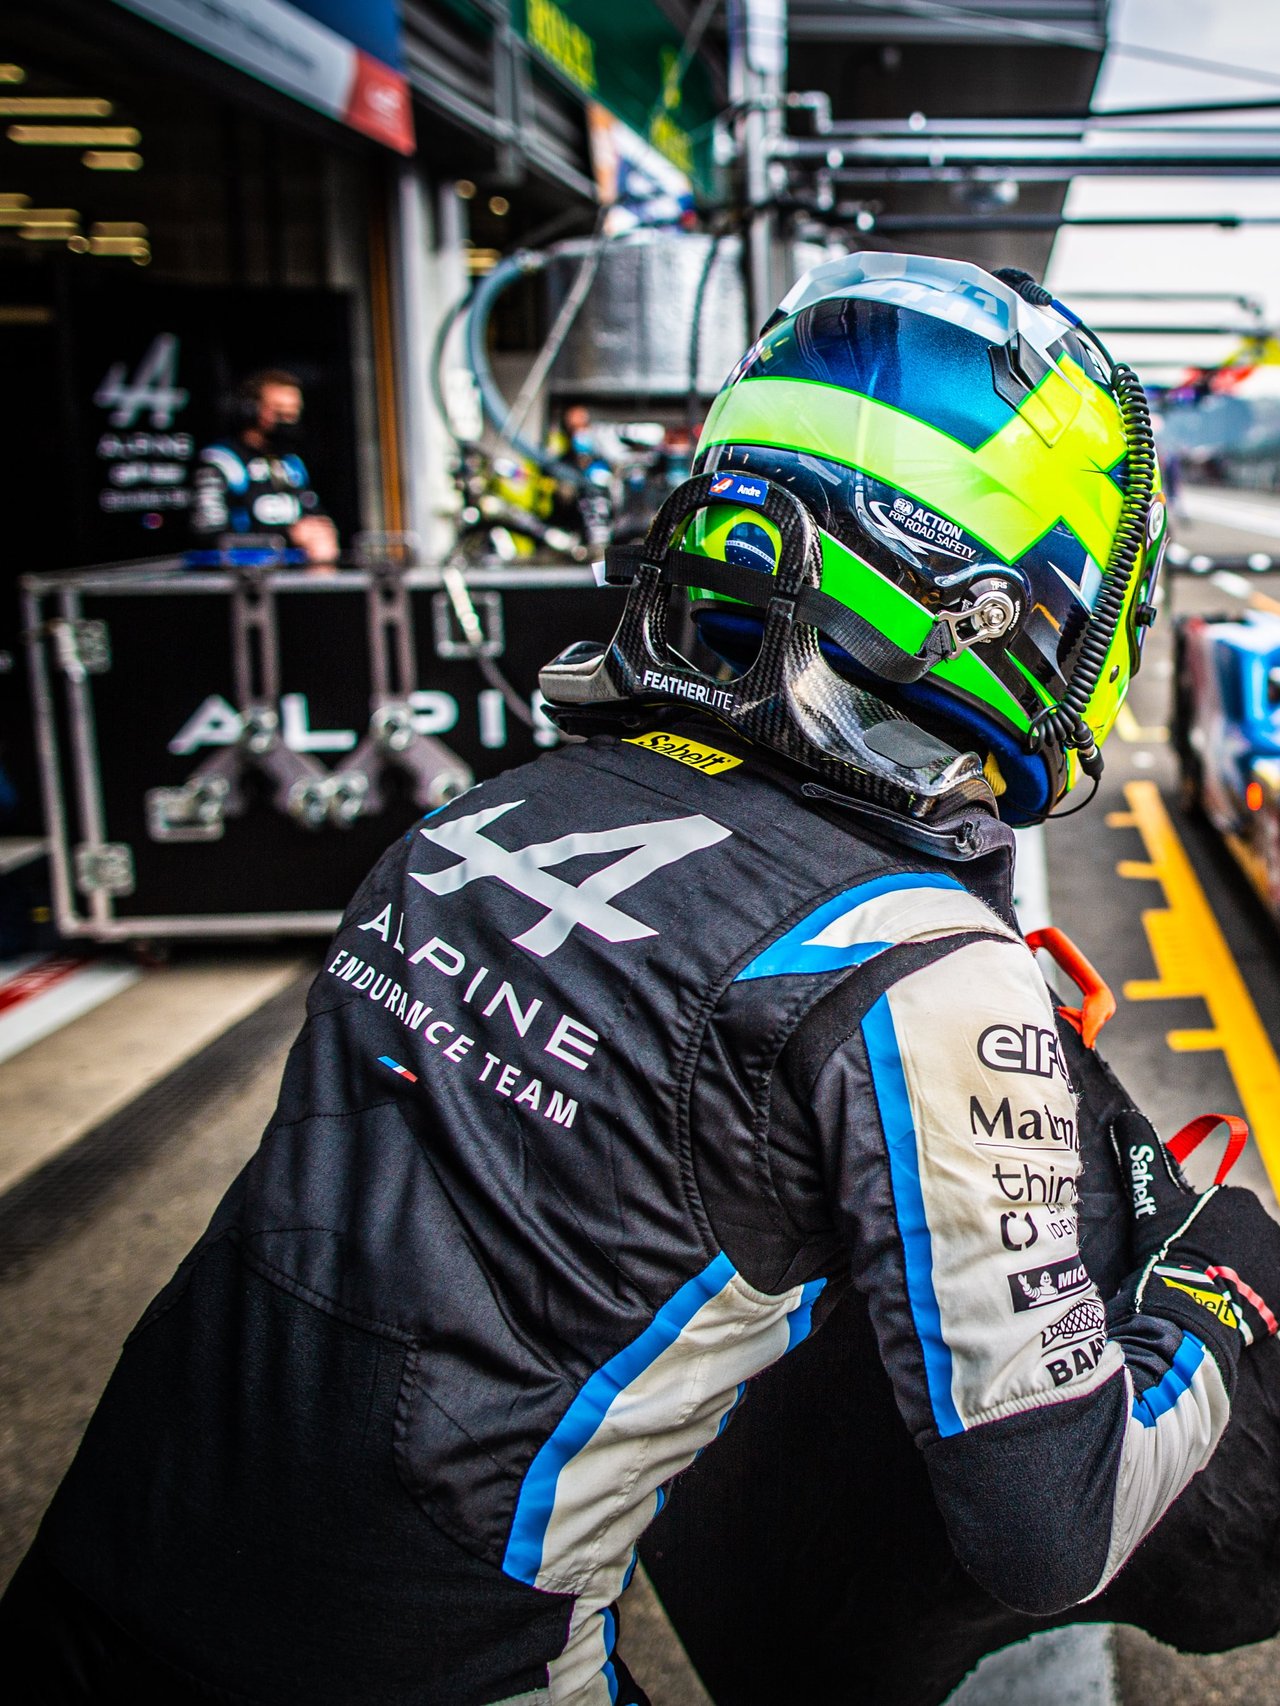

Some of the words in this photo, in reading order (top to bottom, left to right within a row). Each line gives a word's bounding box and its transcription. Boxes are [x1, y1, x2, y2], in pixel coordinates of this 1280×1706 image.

[736, 484, 762, 498] Andre
[888, 510, 906, 523] FOR
[904, 518, 936, 540] ROAD
[934, 533, 977, 559] SAFETY
[911, 508, 964, 540] ACTION
[642, 669, 734, 711] FEATHERLITE
[167, 689, 561, 756] ALPI
[638, 734, 727, 770] Sabelt
[357, 902, 600, 1071] ALPINE
[327, 949, 476, 1063] ENDURANCE
[478, 1051, 580, 1129] TEAM
[977, 1024, 1059, 1079] elf
[969, 1095, 1080, 1152] Matm
